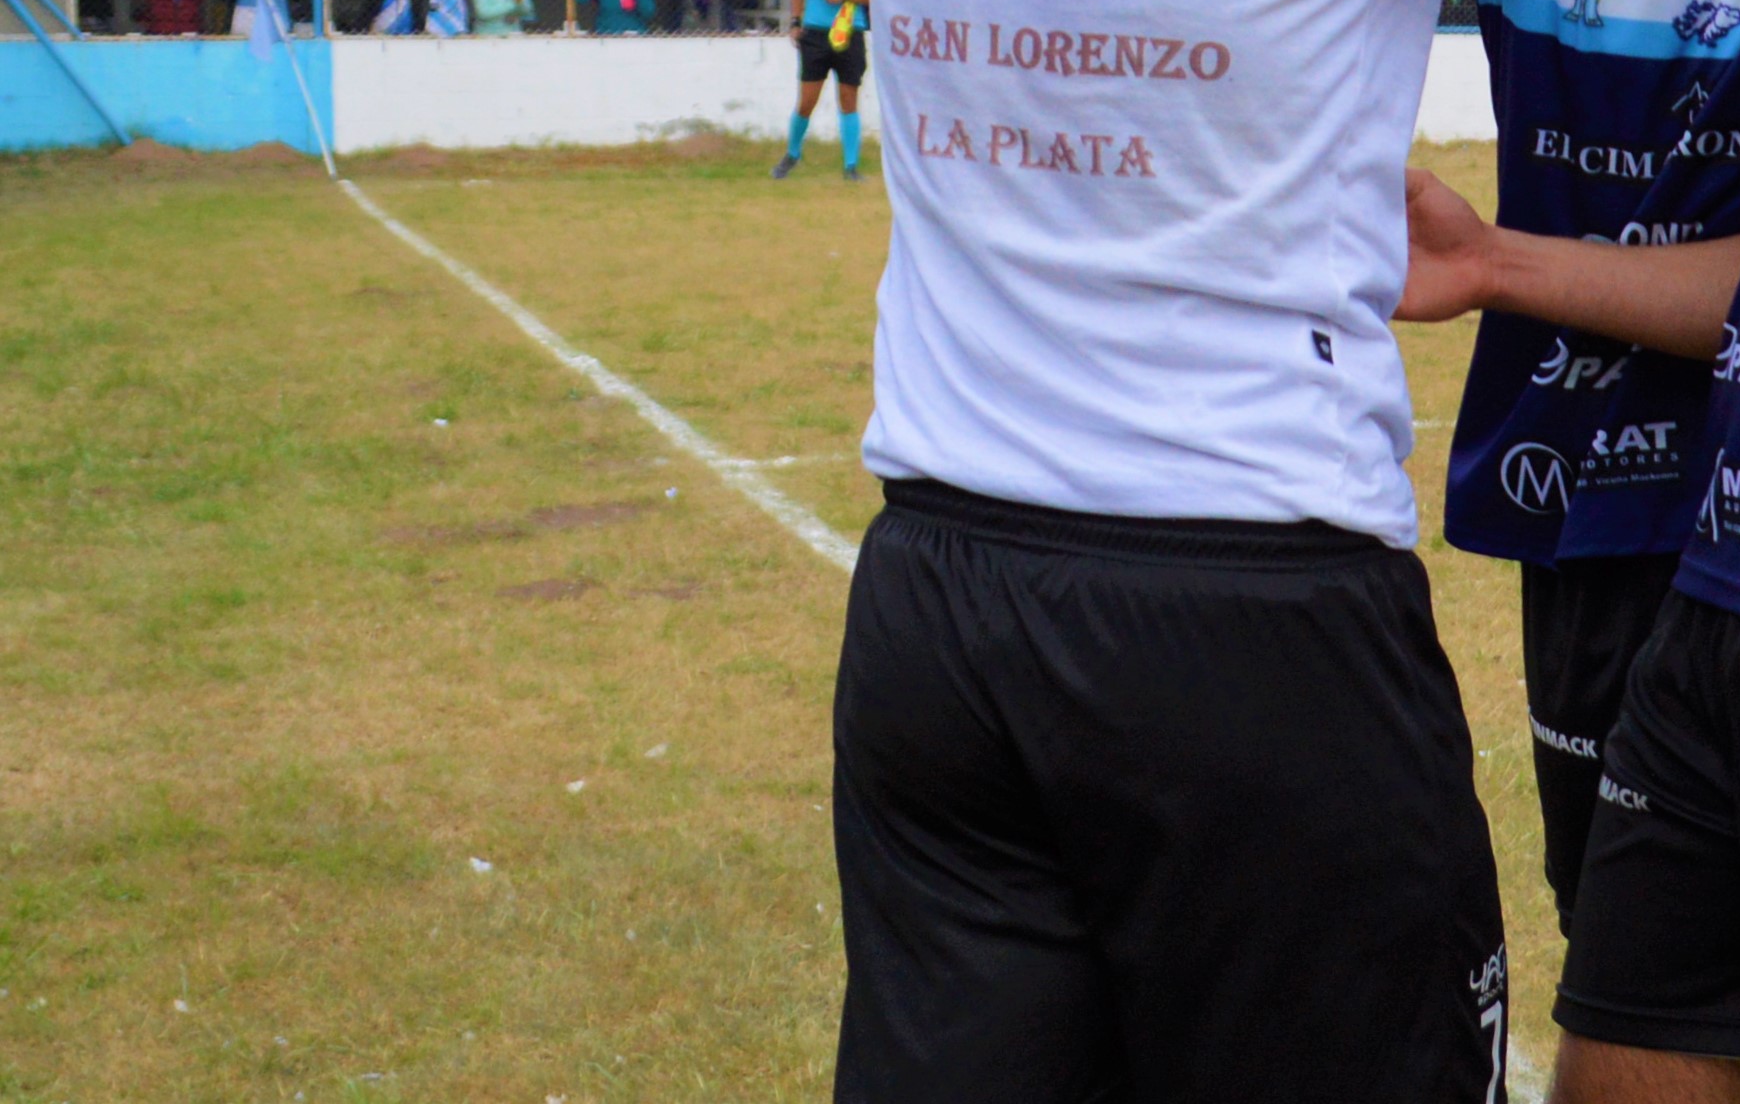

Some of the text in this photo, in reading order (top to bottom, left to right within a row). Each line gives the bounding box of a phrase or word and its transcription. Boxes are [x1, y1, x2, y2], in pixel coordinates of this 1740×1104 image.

[890, 15, 1231, 81] SAN LORENZO
[916, 113, 1157, 178] LA PLATA
[1591, 421, 1678, 456] RAT
